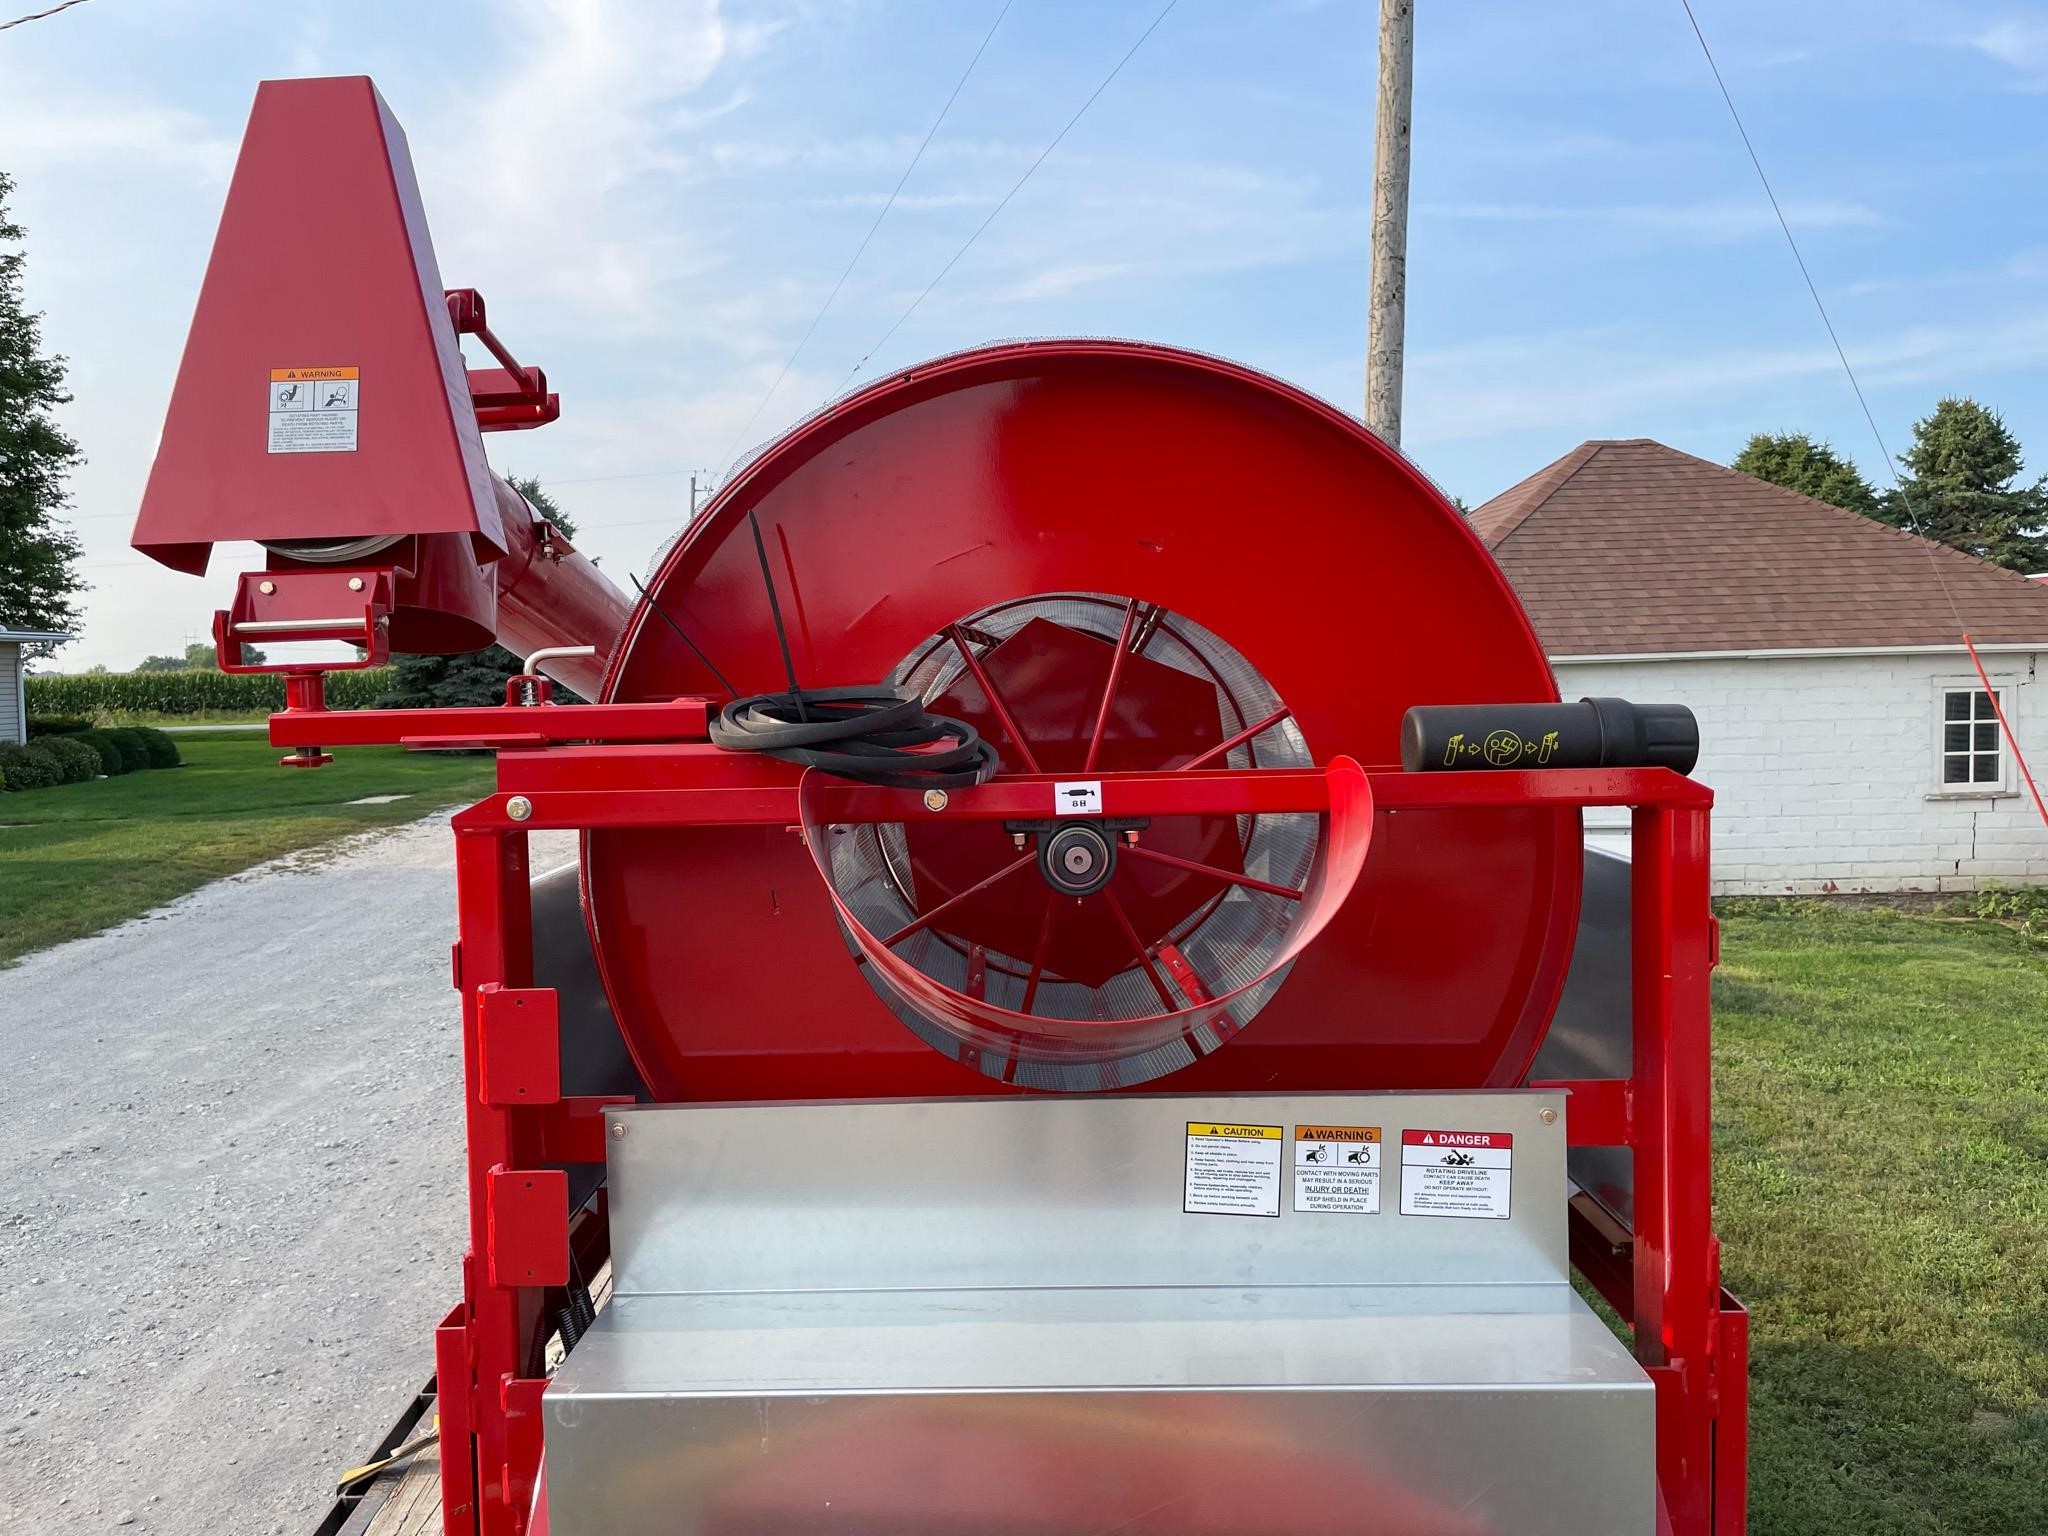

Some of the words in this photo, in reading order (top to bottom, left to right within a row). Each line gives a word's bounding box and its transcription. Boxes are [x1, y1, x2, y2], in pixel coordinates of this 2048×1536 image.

[1223, 1127, 1264, 1137] CAUTION
[1316, 1130, 1373, 1141] WARNING
[1439, 1134, 1490, 1146] DANGER
